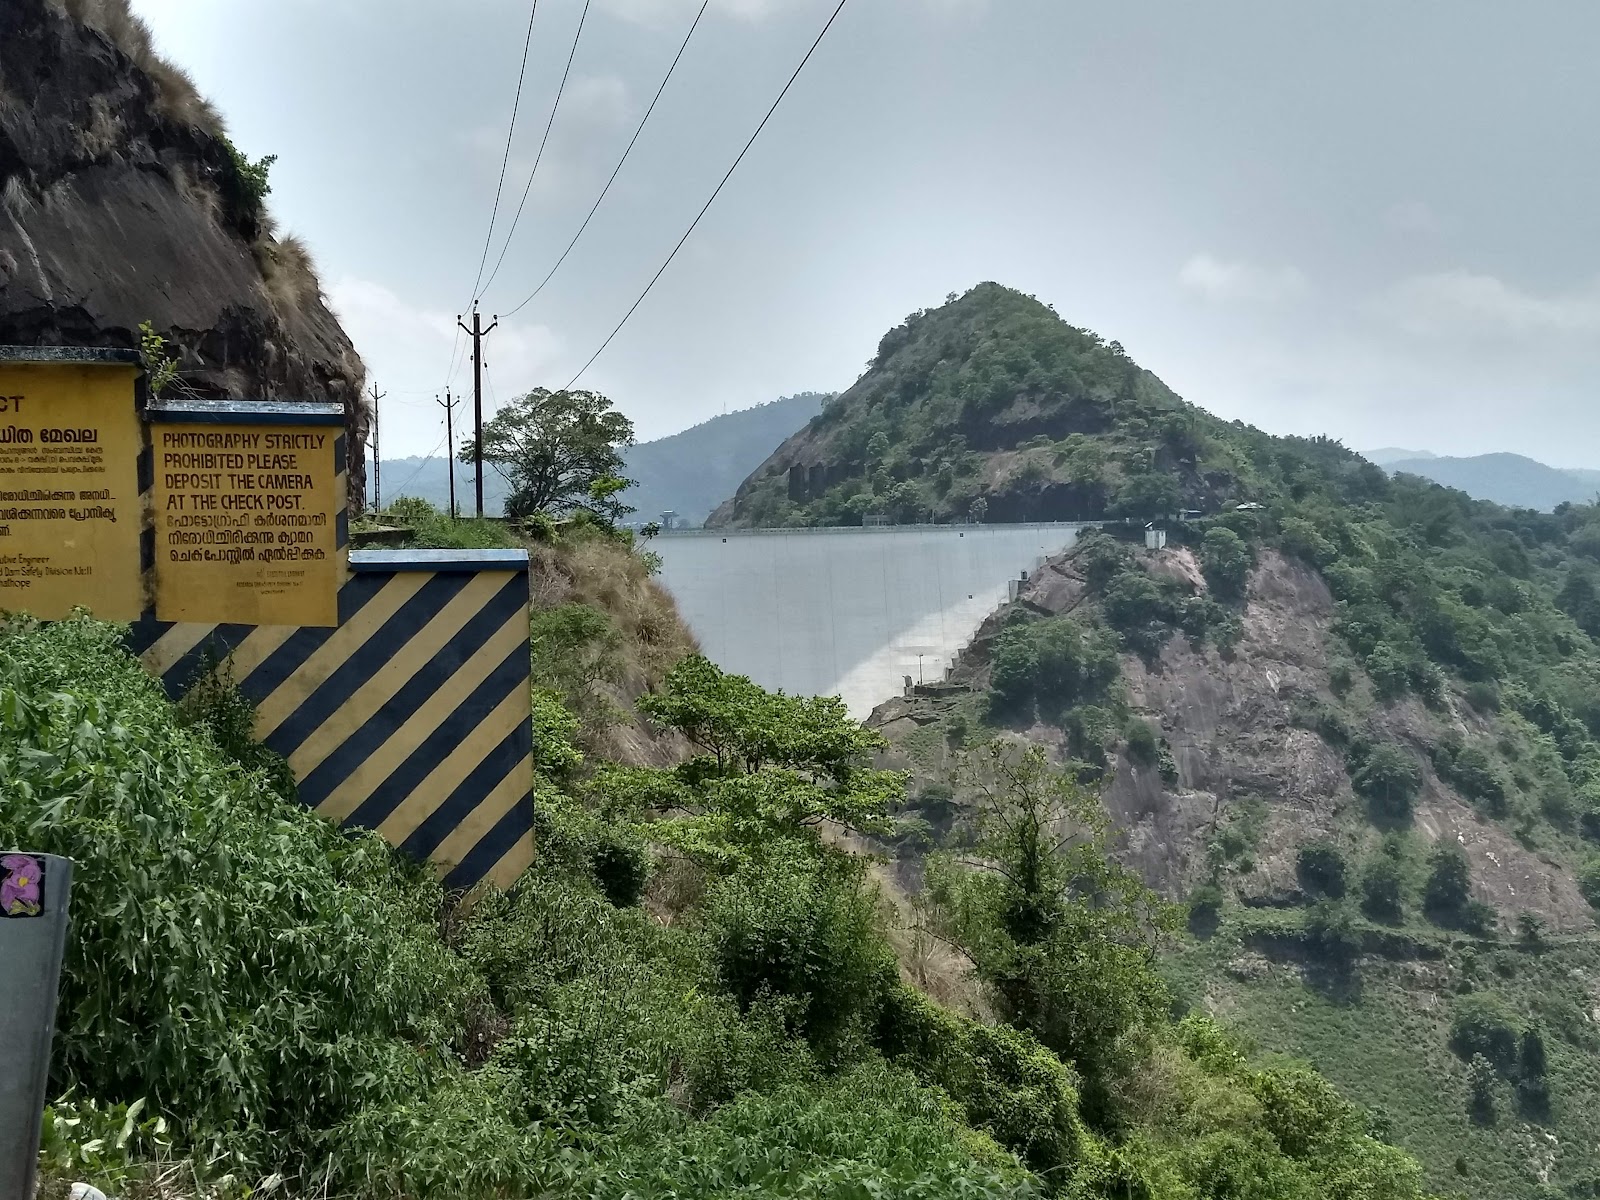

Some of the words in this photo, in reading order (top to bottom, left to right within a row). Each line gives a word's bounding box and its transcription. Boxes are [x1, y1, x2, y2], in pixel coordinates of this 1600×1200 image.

[40, 428, 97, 443] മേഖല
[163, 433, 260, 449] PHOTOGRAPHY
[264, 433, 325, 450] STRICTLY
[164, 454, 244, 469] PROHIBITED
[247, 454, 298, 470] PLEASE
[165, 474, 222, 490] DEPOSIT
[228, 474, 255, 489] THE
[258, 474, 314, 490] CAMERA
[166, 495, 185, 510] AT
[190, 495, 217, 510] THE
[221, 494, 264, 510] CHECK
[267, 495, 305, 510] POST.
[167, 514, 250, 529] ഫോട്ടോഗ്രാഫി
[254, 512, 327, 527] കർശനമായി
[277, 531, 314, 546] ക്യാമറ
